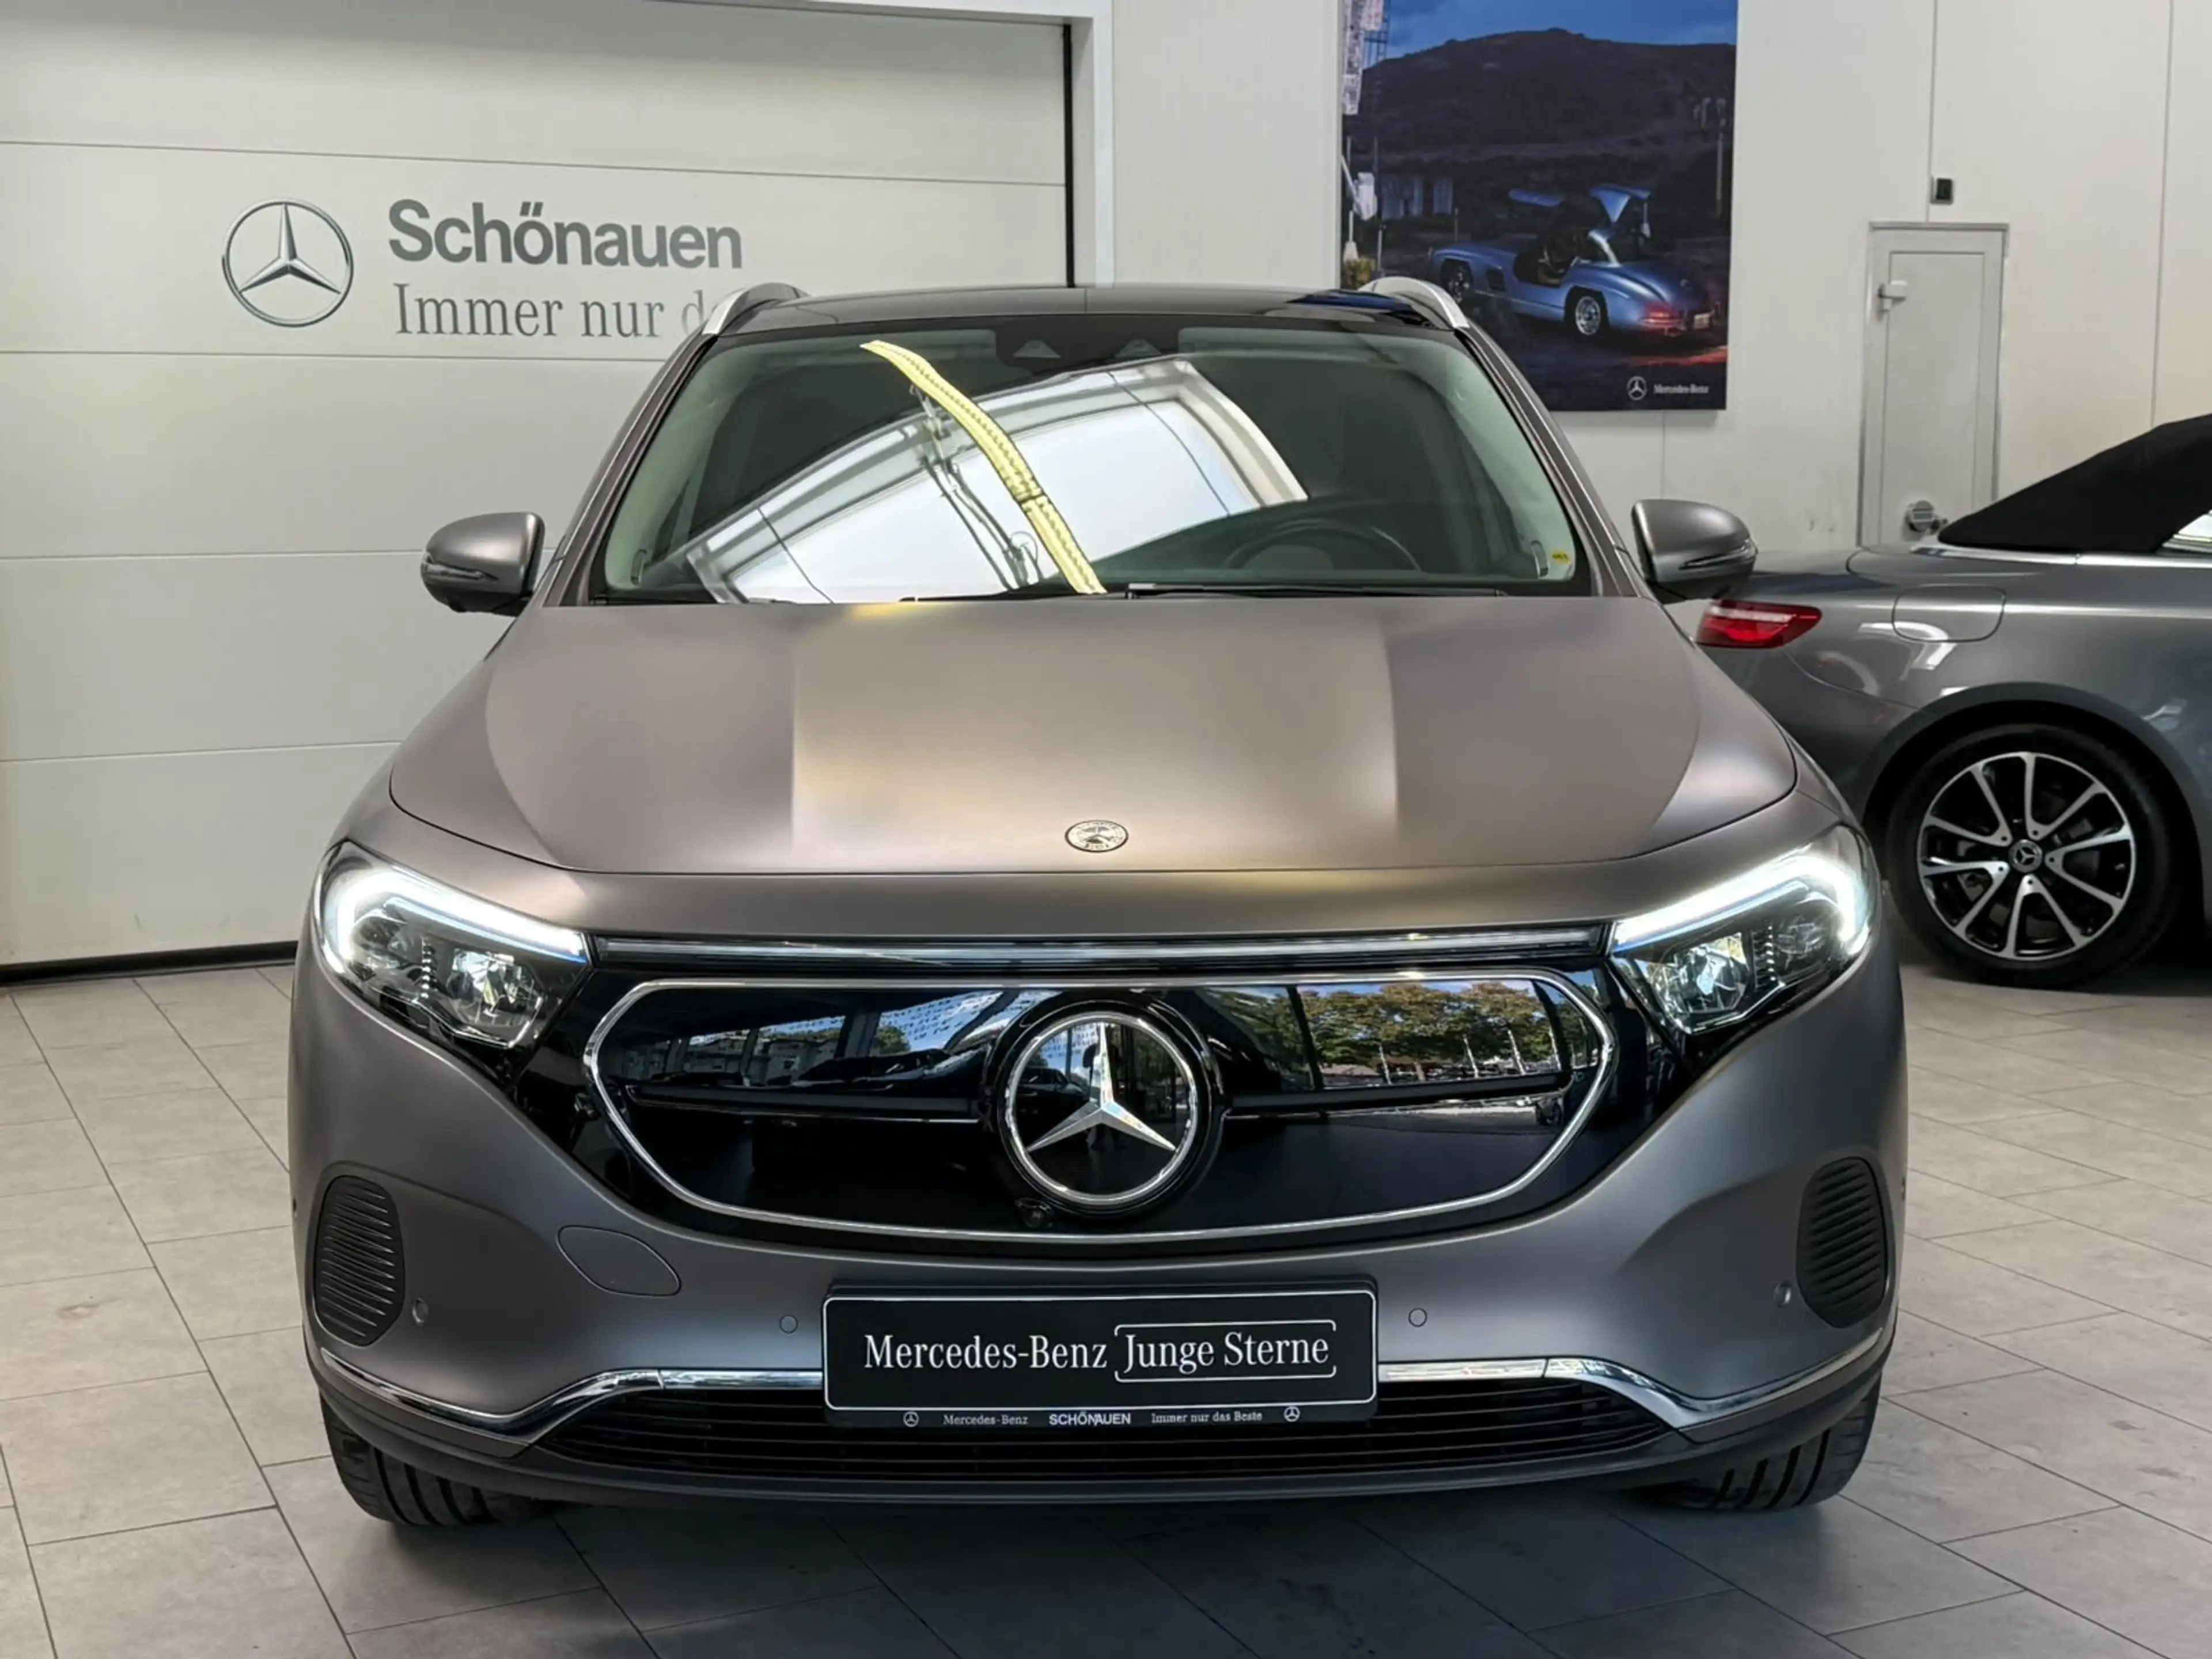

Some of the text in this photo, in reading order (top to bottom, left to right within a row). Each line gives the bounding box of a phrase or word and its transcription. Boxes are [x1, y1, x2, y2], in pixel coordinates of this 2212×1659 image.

[389, 199, 742, 268] Schönauen
[393, 283, 720, 338] Immer nur d
[865, 1331, 1329, 1373] Mercedes-Benz Junge Sterne
[943, 1411, 1263, 1426] Mercedes-Benz SCHÖNAUEN Immer nur das Beste
